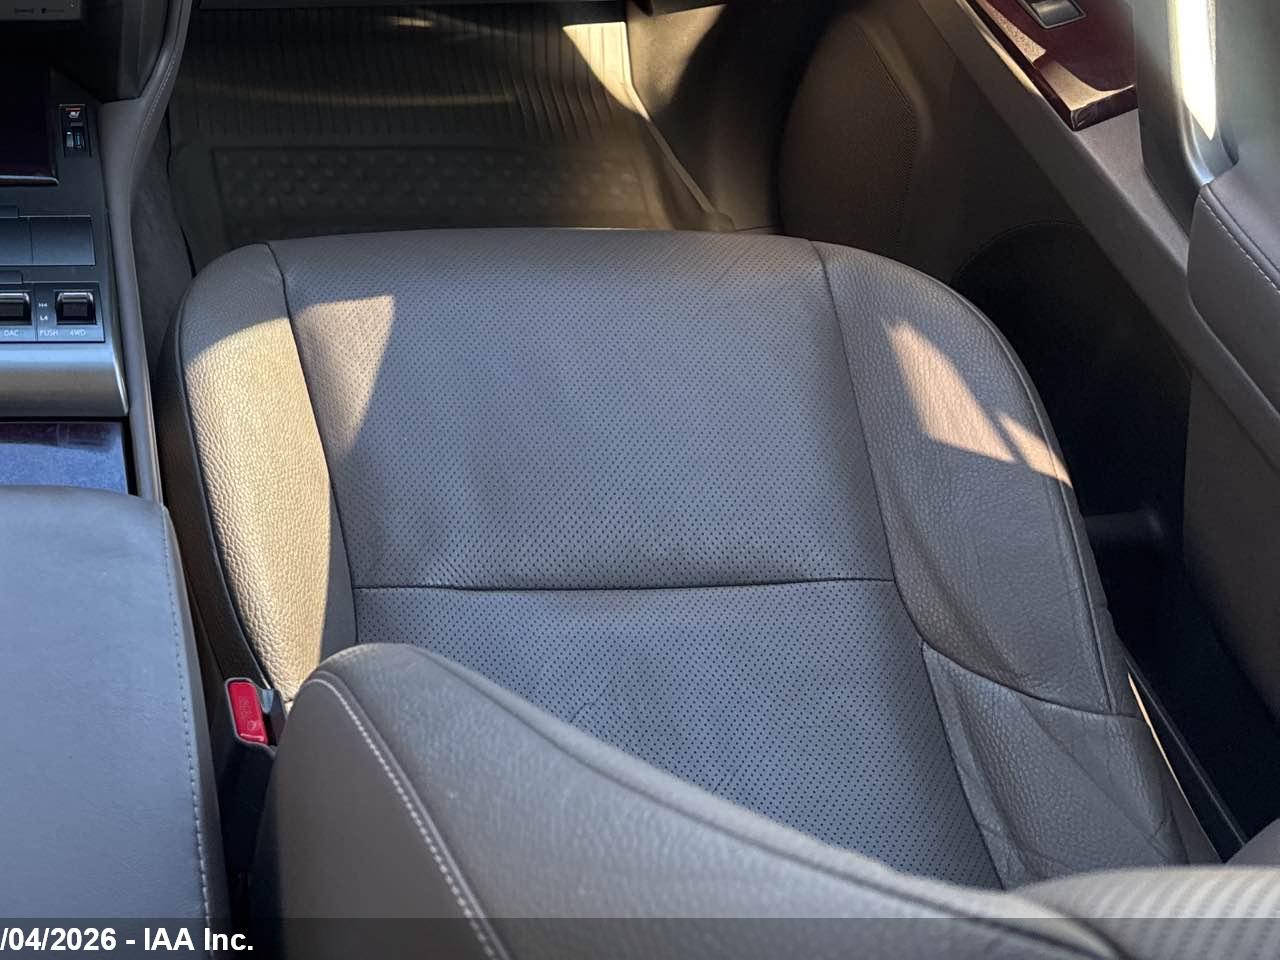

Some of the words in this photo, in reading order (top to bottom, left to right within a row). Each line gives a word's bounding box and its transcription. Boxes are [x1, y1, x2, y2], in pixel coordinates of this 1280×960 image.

[3, 329, 19, 337] DAC
[39, 329, 58, 337] PUSH
[69, 329, 87, 337] 4WD
